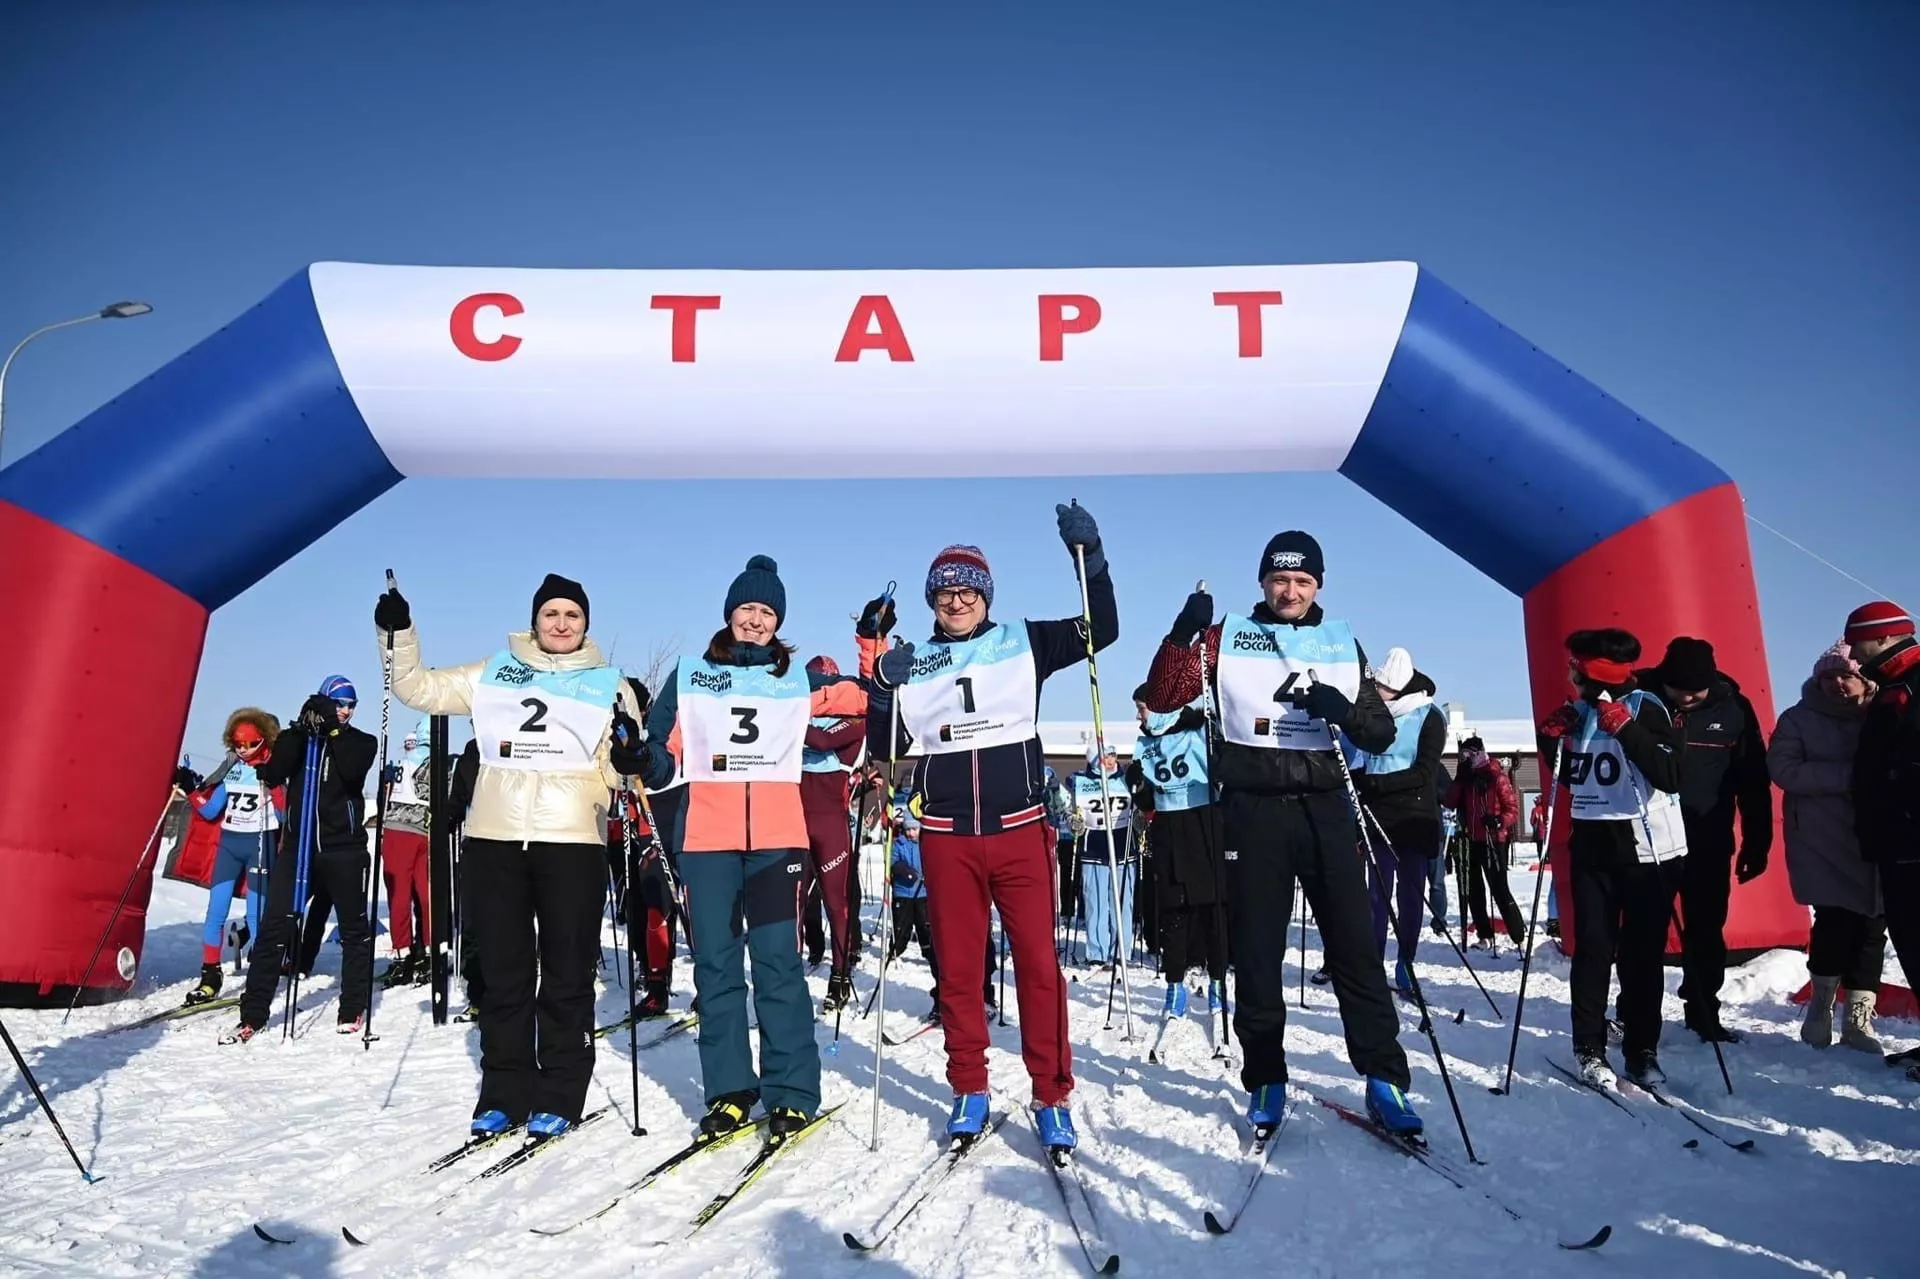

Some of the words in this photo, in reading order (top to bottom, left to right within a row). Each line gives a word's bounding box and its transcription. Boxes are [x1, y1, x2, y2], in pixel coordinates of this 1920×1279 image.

[690, 670, 732, 683] ЛЫЖНЯ
[911, 656, 953, 677] РОССИИ
[690, 678, 732, 692] РОССИИ
[955, 677, 976, 714] 1
[1273, 672, 1306, 710] 4
[518, 697, 548, 733] 2
[729, 707, 760, 744] 3
[1153, 753, 1190, 784] 66
[821, 851, 849, 873] LUKOIL
